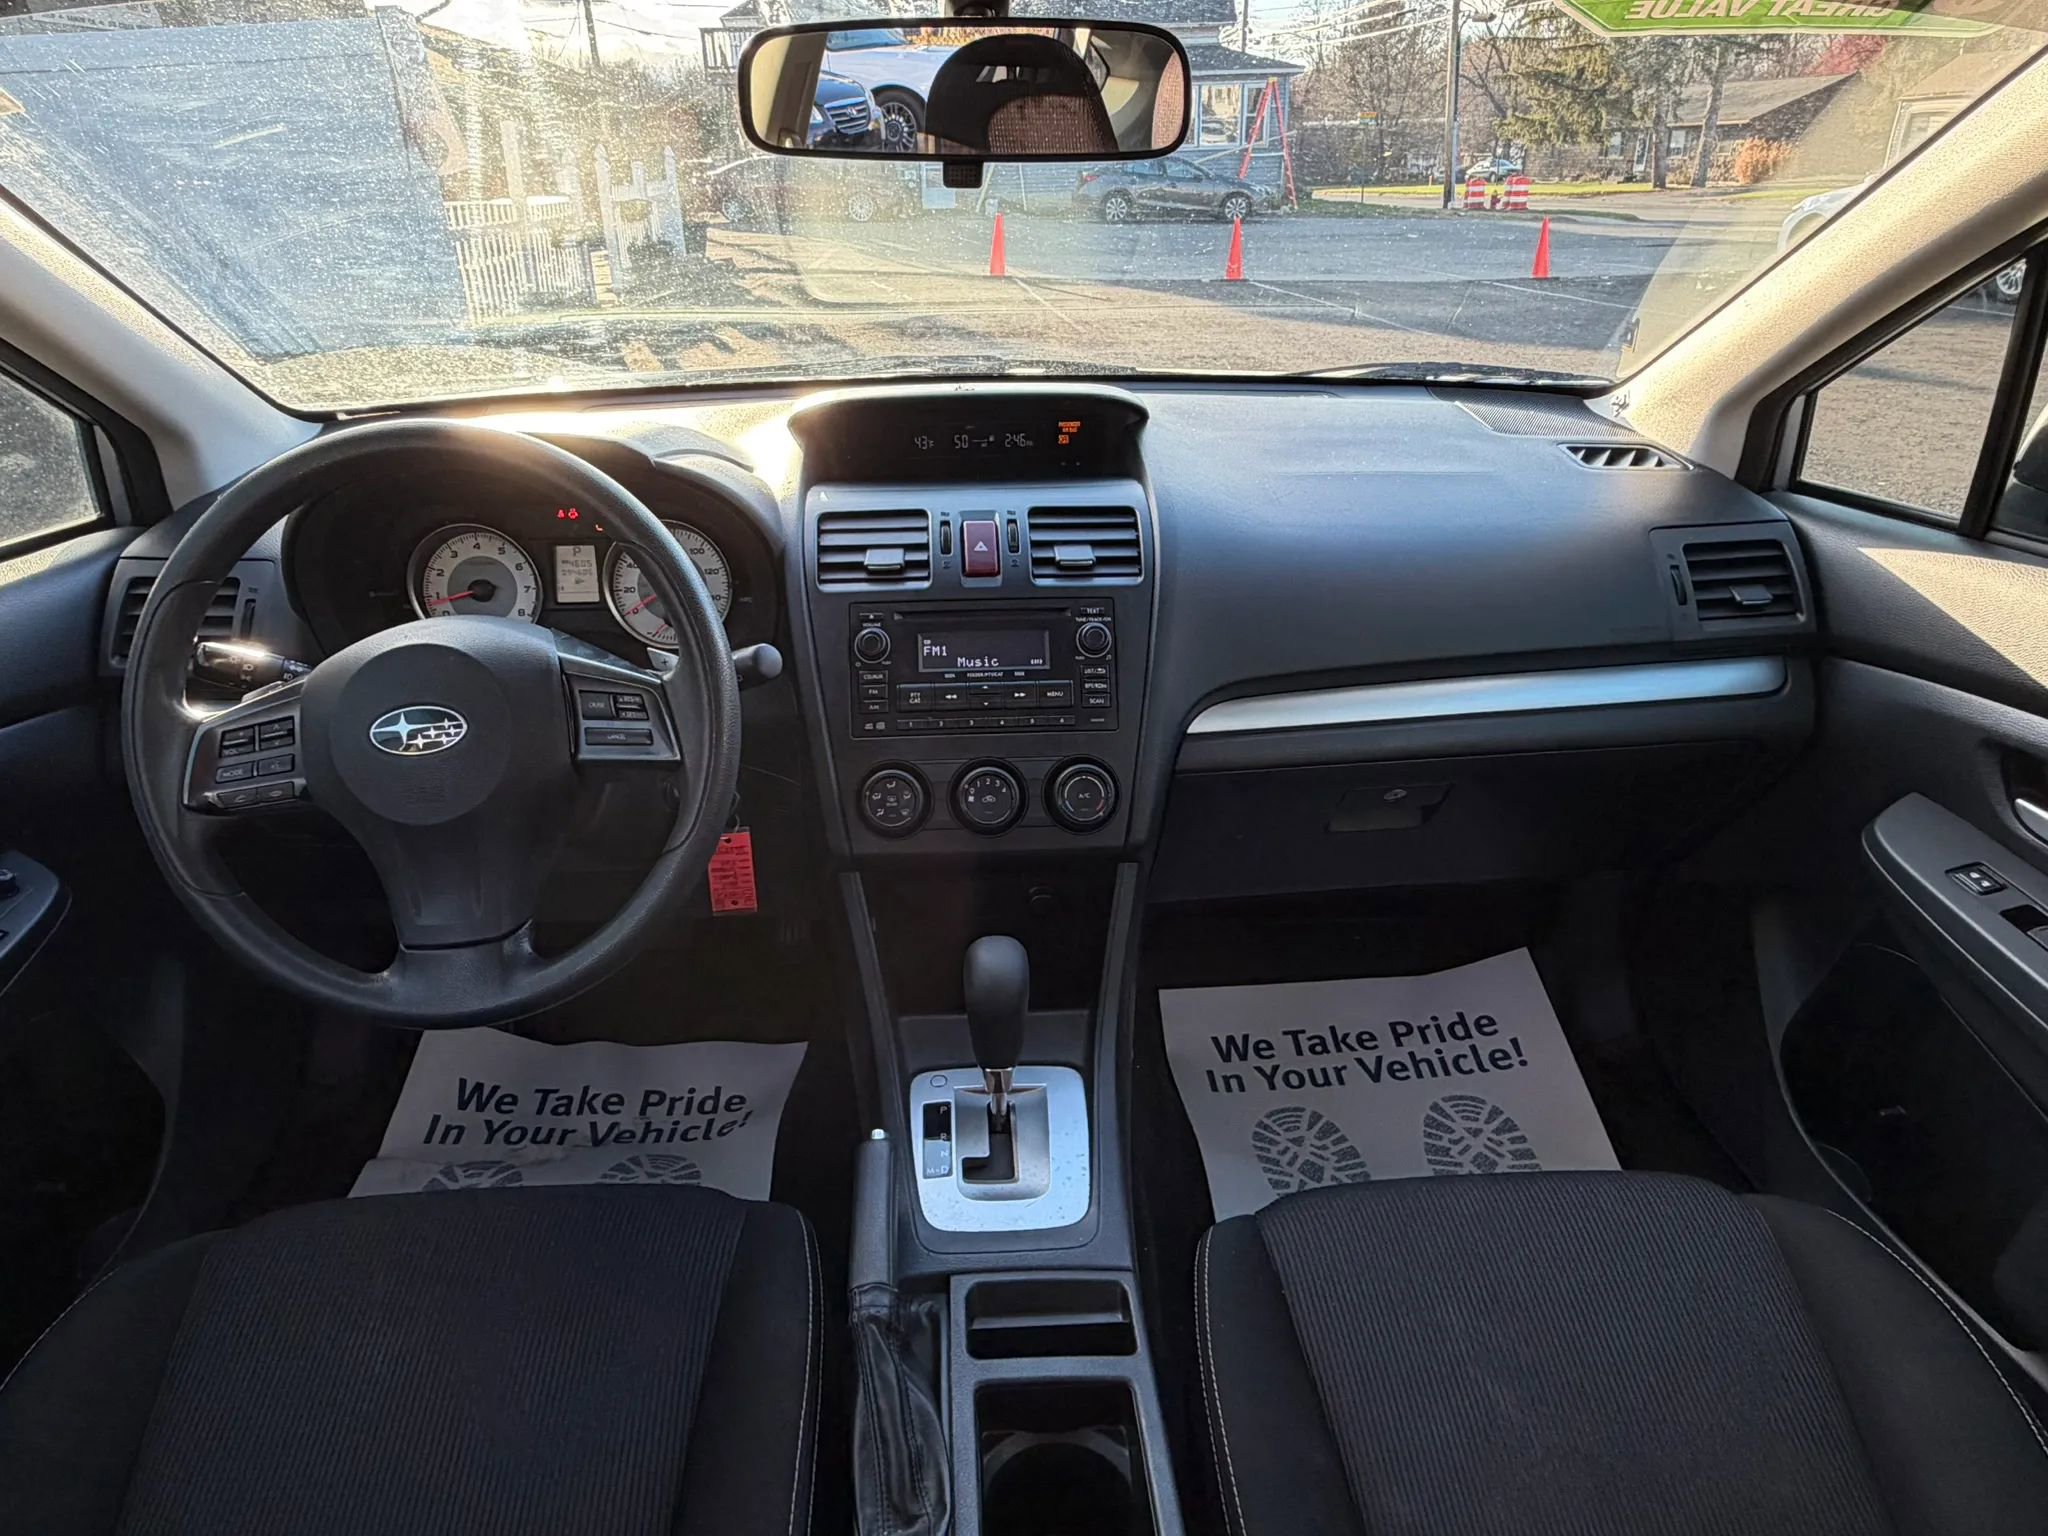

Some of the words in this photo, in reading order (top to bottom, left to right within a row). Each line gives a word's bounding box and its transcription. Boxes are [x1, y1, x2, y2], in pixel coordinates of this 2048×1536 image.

[954, 434, 969, 448] 50
[1005, 433, 1026, 447] 2:46
[450, 550, 458, 558] 3
[498, 547, 506, 555] 5
[573, 546, 581, 556] P
[515, 563, 523, 571] 6
[923, 645, 947, 656] FM1
[957, 656, 999, 667] Music
[222, 769, 243, 777] MODE
[1210, 1033, 1277, 1064] We
[1281, 1025, 1380, 1058] Take
[1388, 1011, 1500, 1048] Pride
[1205, 1069, 1246, 1093] In
[1253, 1064, 1349, 1093] Your
[1353, 1036, 1529, 1085] Vehicle!
[457, 1078, 519, 1115] We
[533, 1084, 625, 1116] Take
[639, 1085, 748, 1117] Pride
[941, 1106, 947, 1114] P
[422, 1114, 466, 1146] In
[483, 1119, 578, 1147] Your
[588, 1110, 755, 1148] Vehicle!
